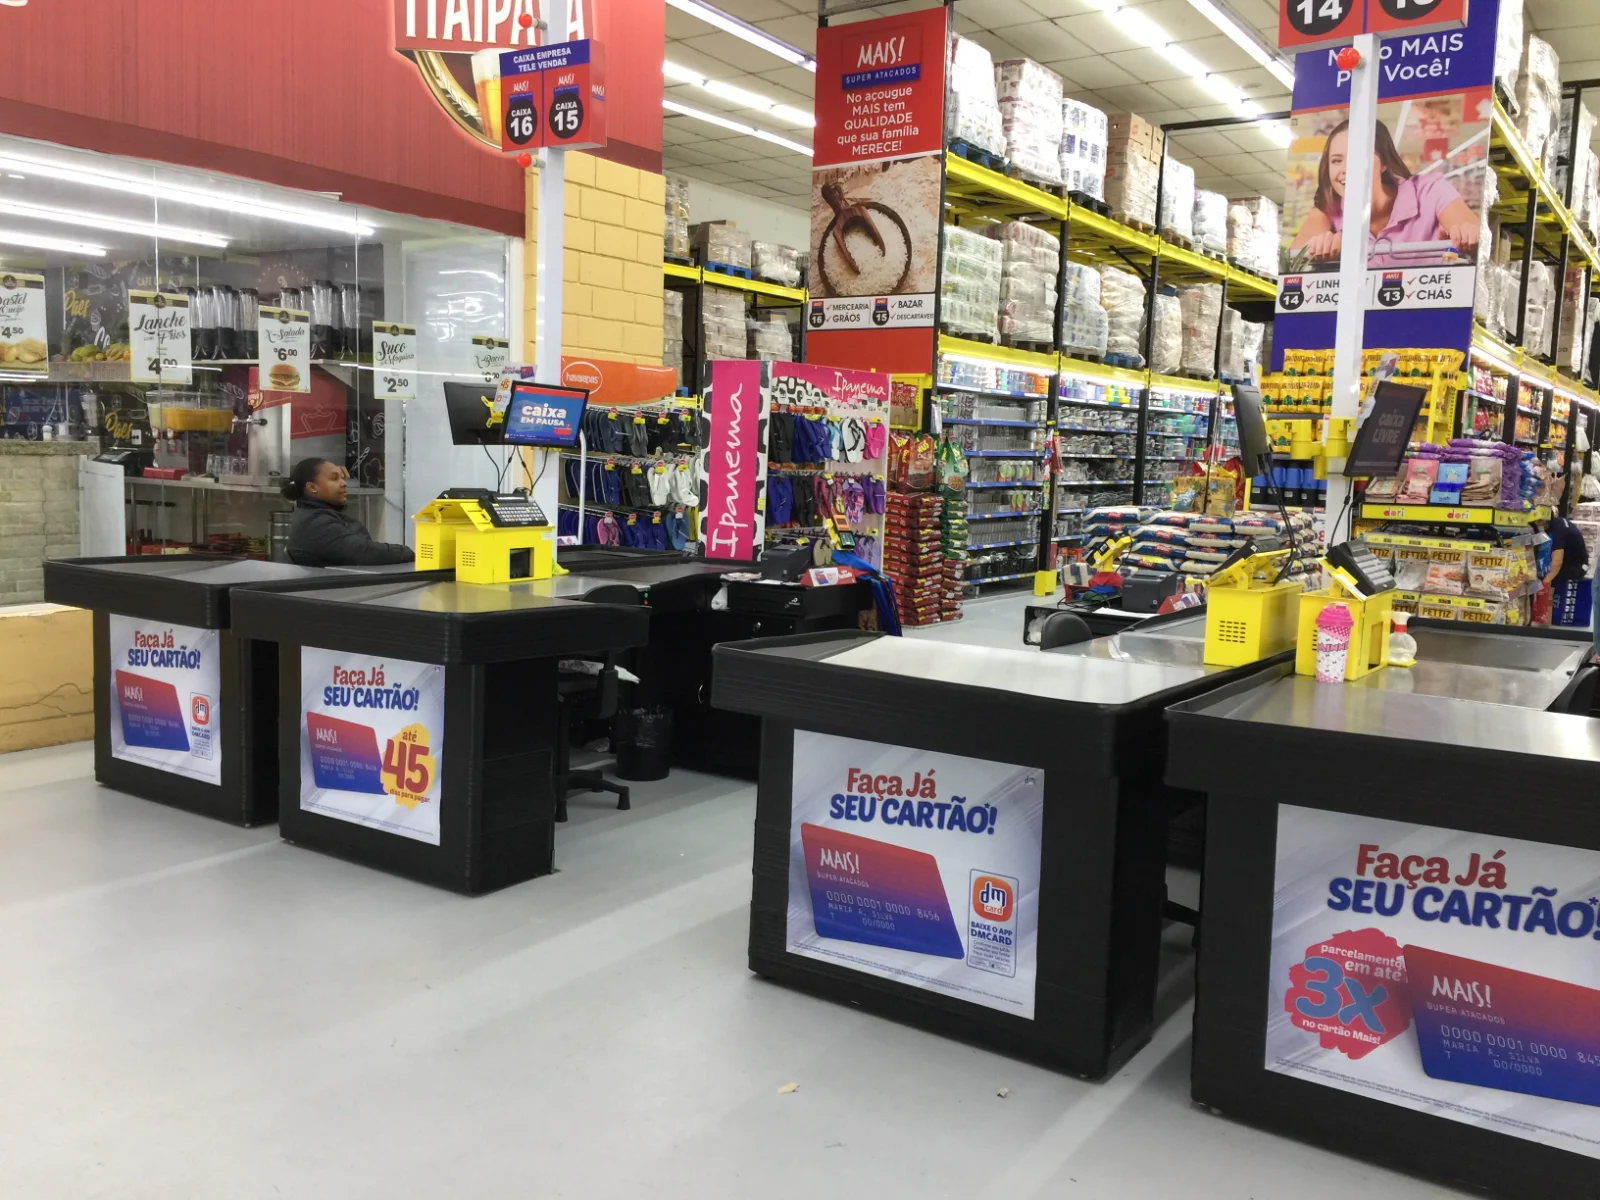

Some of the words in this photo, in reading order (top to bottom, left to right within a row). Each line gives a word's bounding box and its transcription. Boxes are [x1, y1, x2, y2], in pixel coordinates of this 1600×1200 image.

[1296, 0, 1343, 25] 14
[406, 0, 586, 46] ITAIPAA
[857, 36, 905, 69] MAIS!
[1401, 33, 1464, 58] MAIS
[513, 54, 535, 64] CAIXA
[536, 47, 572, 60] EMPRESA
[518, 63, 537, 72] TELE
[538, 58, 567, 70] VENDAS
[1384, 58, 1451, 82] Você!
[558, 73, 575, 86] MAIS!
[846, 73, 872, 84] SUPER
[874, 66, 918, 80] ATACADOS
[513, 80, 529, 93] MAIS!
[846, 93, 863, 104] No
[864, 87, 913, 102] açougue
[511, 108, 532, 117] CAIXA
[556, 101, 578, 111] CAIXA
[852, 103, 881, 117] MAIS
[883, 101, 906, 113] tem
[510, 116, 533, 137] 16
[554, 109, 579, 131] 15
[844, 112, 913, 131] QUALIDADE
[837, 134, 858, 146] que
[860, 131, 879, 142] sua
[881, 126, 919, 139] família
[852, 140, 903, 156] MERECE!
[1316, 279, 1340, 290] LINH
[1418, 270, 1452, 285] CAFÉ
[0, 292, 28, 307] astel
[1283, 296, 1300, 306] 14
[1316, 293, 1339, 306] RAÇ
[1383, 291, 1401, 302] 13
[1416, 285, 1453, 300] CHÁS
[832, 303, 869, 311] MERCEARIA
[898, 300, 924, 309] BAZAR
[134, 311, 187, 335] Lanche
[811, 315, 823, 324] 16
[832, 312, 861, 323] GRÃOS
[875, 313, 888, 322] 15
[375, 341, 408, 362] Suco
[832, 371, 886, 396] Ipanema
[522, 403, 567, 419] caixa
[1378, 408, 1405, 427] caixa
[521, 417, 534, 425] EM
[540, 418, 565, 427] PAUSA
[1372, 428, 1401, 444] LIVRE
[712, 382, 748, 558] Ipanema
[1383, 507, 1405, 517] dori
[1447, 508, 1469, 519] dori
[1432, 551, 1462, 561] PETTIZ
[1474, 556, 1503, 567] PETTIZ
[1422, 607, 1451, 619] PETTIZ
[1463, 611, 1492, 622] PETTIZ
[134, 630, 160, 652] Faça
[161, 629, 174, 648] Já
[128, 648, 149, 667] SEU
[150, 645, 201, 670] CARTÃO!
[333, 665, 366, 691] Faça
[368, 664, 386, 687] Já
[124, 685, 143, 701] MAIS!
[324, 686, 351, 707] SEU
[353, 683, 420, 711] CARTÃO!
[316, 727, 337, 744] MAIS!
[402, 729, 418, 743] até
[383, 738, 430, 794] 45
[389, 787, 401, 797] dias
[401, 790, 414, 800] para
[847, 768, 903, 801] Faça
[906, 768, 937, 799] Já
[829, 794, 876, 823] SEU
[881, 796, 998, 835] CARTÃO!
[820, 848, 860, 875] MAIS!
[1356, 843, 1450, 890] Faça
[1456, 849, 1508, 890] Já
[817, 871, 838, 883] SUPER
[839, 876, 870, 889] ATACADOS
[980, 881, 1007, 909] dm
[1327, 877, 1405, 917] SEU
[826, 890, 854, 906] 0000
[857, 895, 882, 911] 0001
[886, 902, 911, 917] 0000
[917, 909, 940, 922] 8456
[828, 903, 853, 913] MARIA
[873, 911, 894, 922] SILVA
[985, 905, 1003, 915] card
[862, 917, 896, 931] 00/0000
[971, 921, 991, 932] BAIXE
[999, 928, 1013, 937] APP
[971, 928, 1012, 946] DMCARD
[1321, 944, 1404, 970] parcelamento
[1345, 960, 1370, 976] em
[1374, 965, 1402, 983] até
[1432, 975, 1492, 1008] MAIS!
[1427, 1002, 1458, 1014] SUPER
[1461, 1009, 1506, 1025] ATACADOS
[1302, 1019, 1316, 1029] no
[1317, 1022, 1351, 1038] cartão
[1353, 1029, 1381, 1045] Mais!
[1441, 1025, 1482, 1043] 0000
[1487, 1033, 1524, 1050] 0001
[1530, 1042, 1567, 1060] 0000
[1443, 1040, 1479, 1053] MARIA
[1488, 1048, 1500, 1058] A.
[1508, 1052, 1541, 1065] SILVA
[1446, 1051, 1451, 1060] T
[1493, 1059, 1542, 1076] 00/0000
